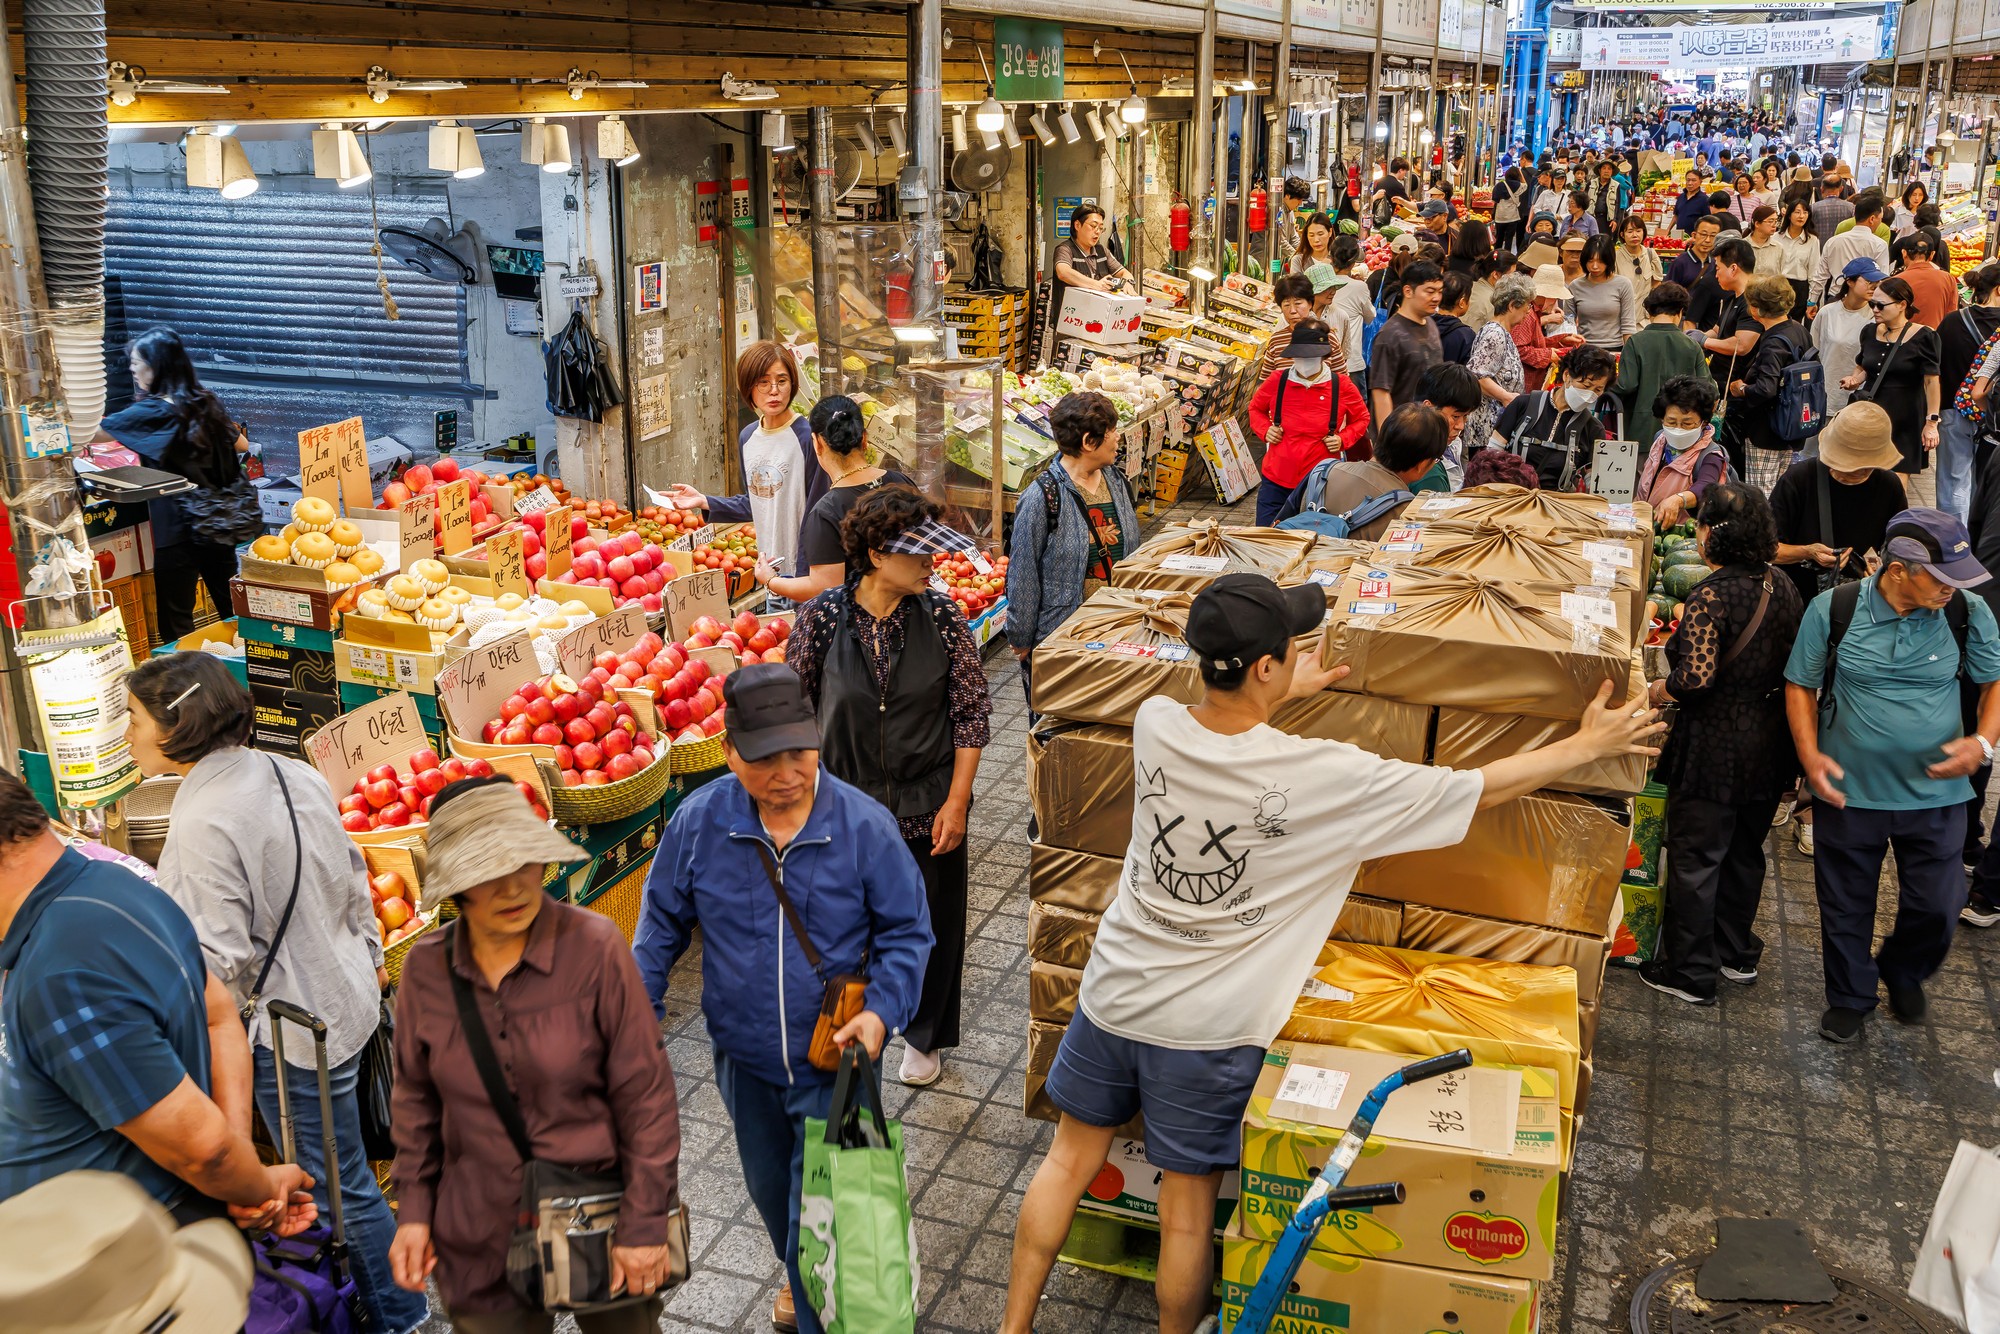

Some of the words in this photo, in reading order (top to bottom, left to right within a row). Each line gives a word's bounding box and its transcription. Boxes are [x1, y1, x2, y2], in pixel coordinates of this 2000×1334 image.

[1001, 44, 1024, 78] 강오
[1040, 45, 1060, 78] 상회
[700, 200, 718, 221] CCT
[1063, 316, 1084, 327] 사과
[1111, 319, 1127, 330] 사과
[122, 530, 132, 550] 사과
[500, 546, 519, 567] 3개
[688, 573, 718, 600] 만원
[598, 614, 635, 646] 만원
[247, 645, 289, 660] 스테비아사과
[488, 641, 524, 671] 만원
[574, 628, 596, 671] 4개
[460, 649, 487, 704] 4개
[255, 712, 298, 727] 스테비아사과
[367, 706, 408, 745] 만원
[330, 721, 364, 769] 7개
[1629, 868, 1647, 879] 20kg
[1476, 1161, 1513, 1170] RECOMMENDED
[1246, 1196, 1358, 1231] BANAS
[1451, 1224, 1473, 1240] Del
[1476, 1227, 1522, 1246] Monte
[1227, 1286, 1320, 1318] Prium
